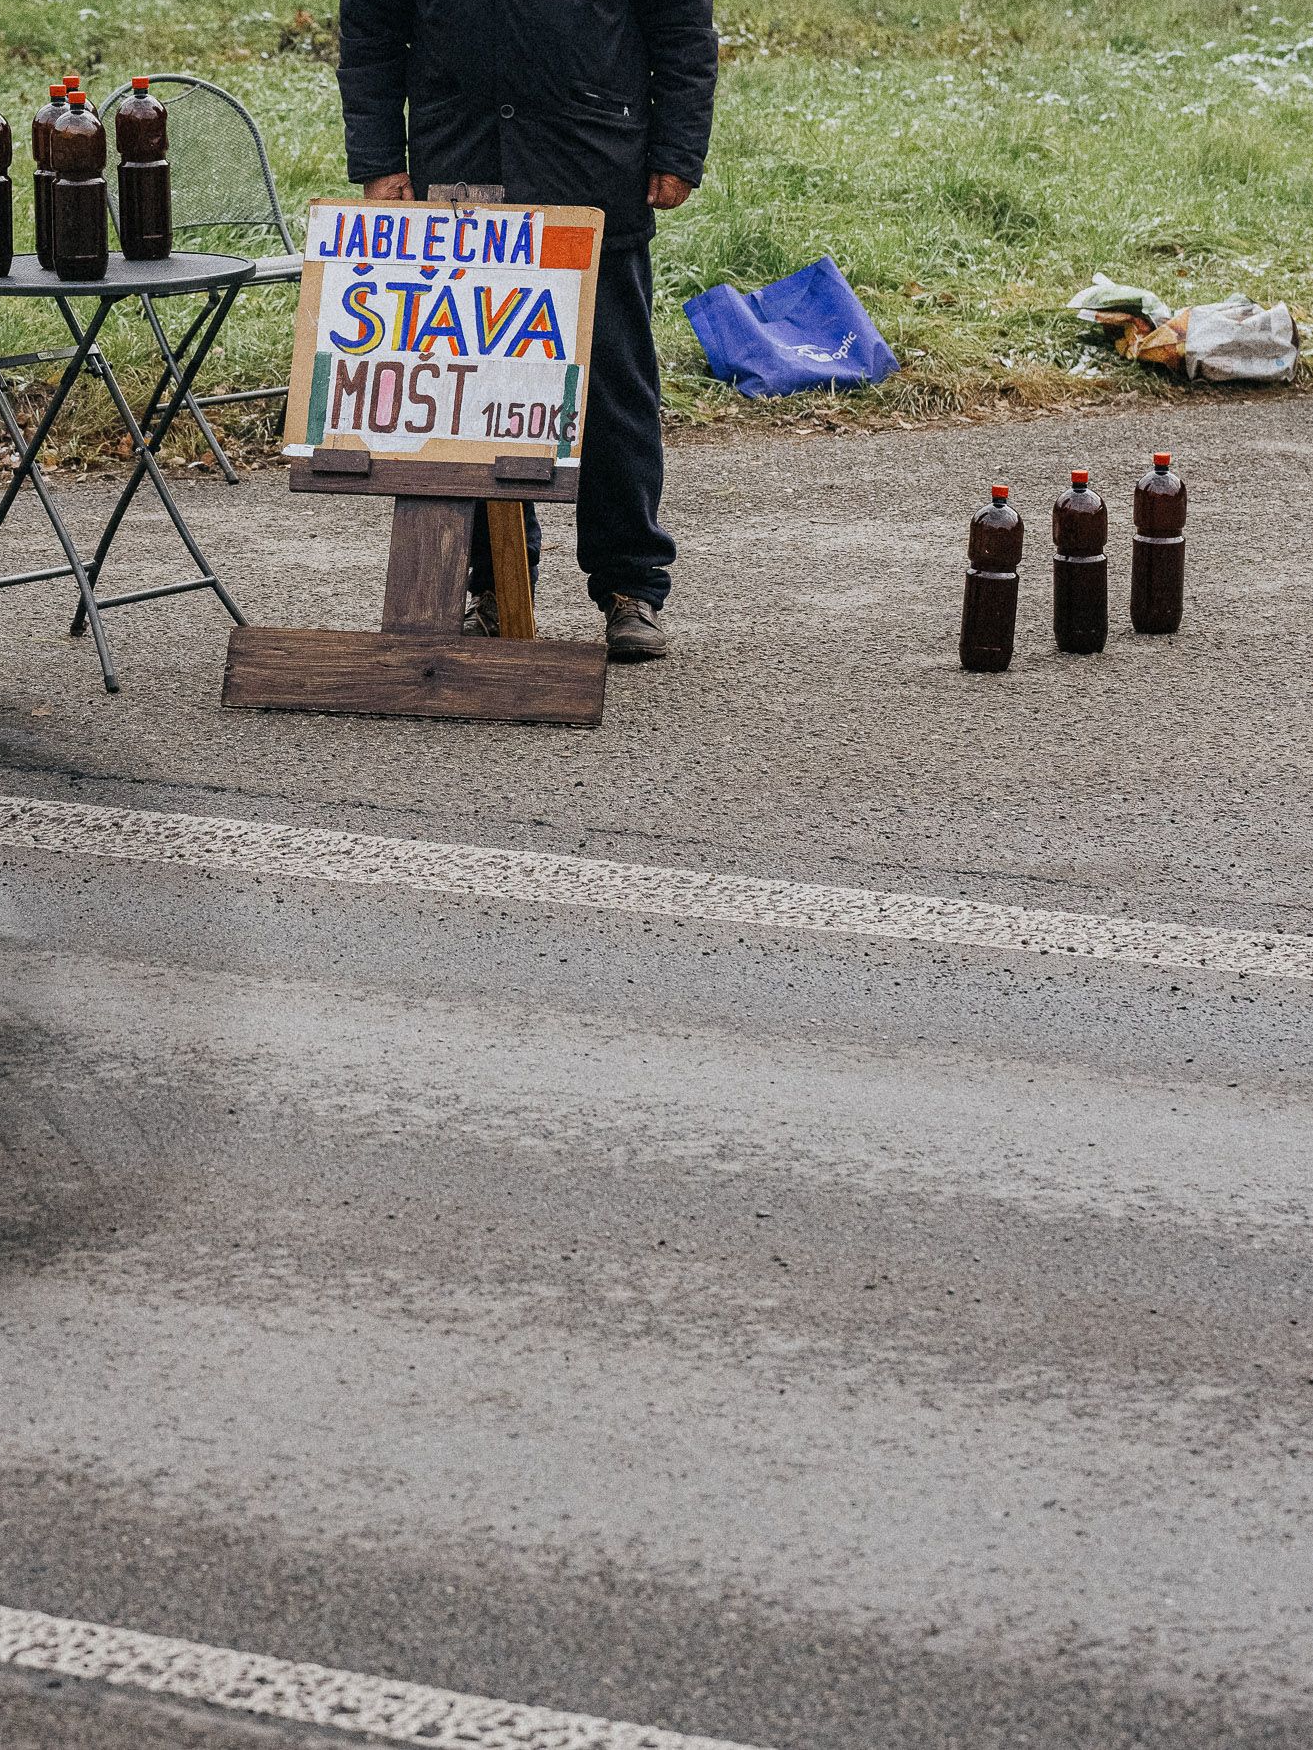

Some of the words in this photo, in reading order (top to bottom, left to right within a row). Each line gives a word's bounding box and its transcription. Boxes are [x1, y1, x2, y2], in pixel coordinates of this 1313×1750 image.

[319, 210, 535, 264] JABLEČNÁ
[329, 263, 566, 360] ŠŤÁVA
[832, 331, 857, 359] optic
[330, 352, 478, 436] MOŠT
